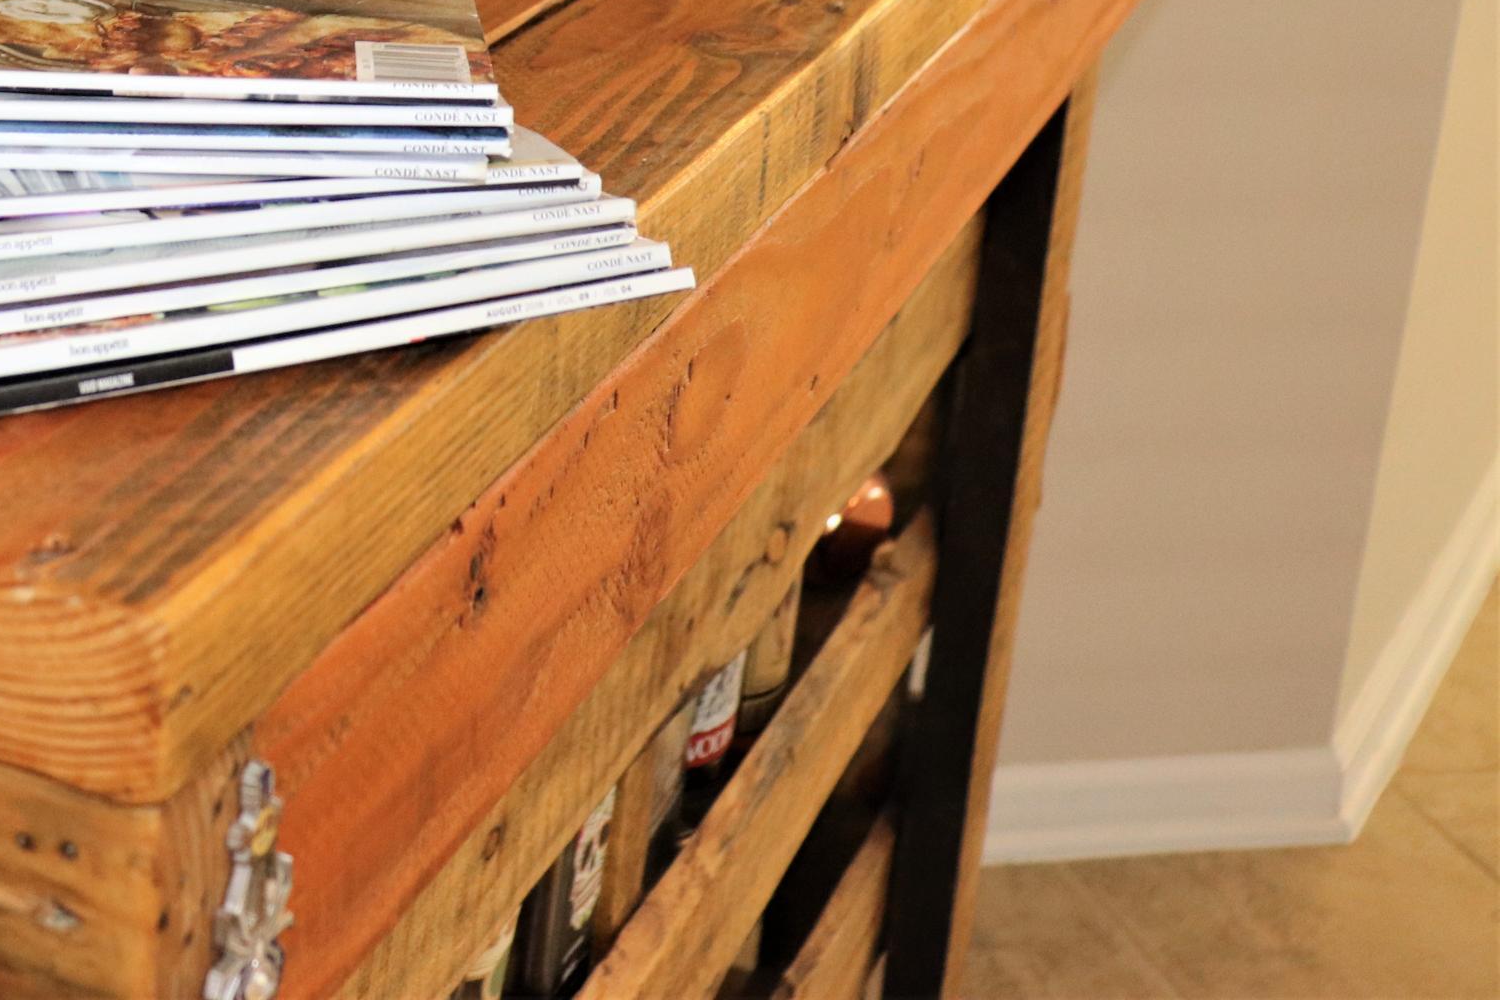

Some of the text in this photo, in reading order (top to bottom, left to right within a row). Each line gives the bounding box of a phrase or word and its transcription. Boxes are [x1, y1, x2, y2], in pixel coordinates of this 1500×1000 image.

[463, 111, 499, 123] NAST
[453, 144, 487, 154] NAST
[423, 168, 459, 180] NAST
[529, 165, 560, 176] NAST
[573, 204, 602, 216] NAST
[594, 234, 622, 246] NAST
[625, 252, 653, 265] NAST
